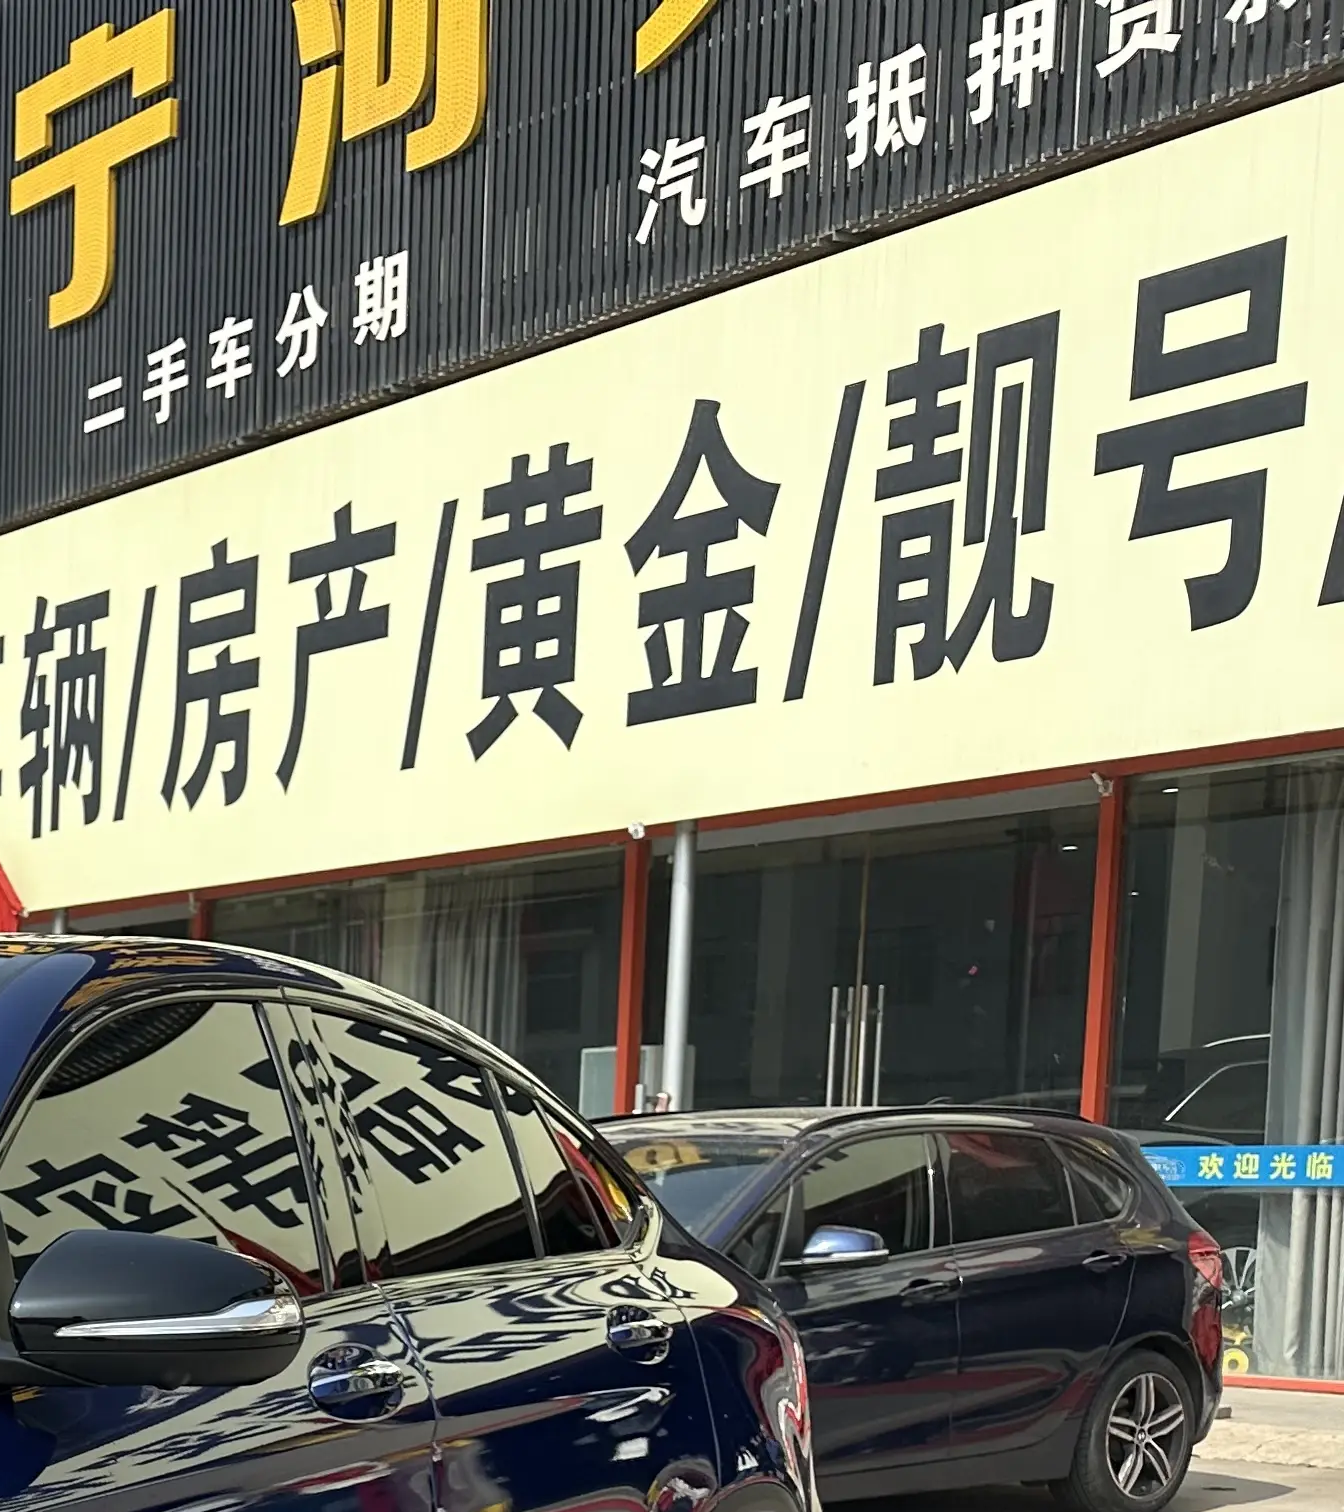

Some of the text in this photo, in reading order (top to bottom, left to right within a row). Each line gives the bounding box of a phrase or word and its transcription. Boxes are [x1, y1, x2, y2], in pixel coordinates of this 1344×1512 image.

[84, 0, 1298, 434] 二手车分期 汽车抵押贷
[1198, 1152, 1334, 1180] 欢迎光临
